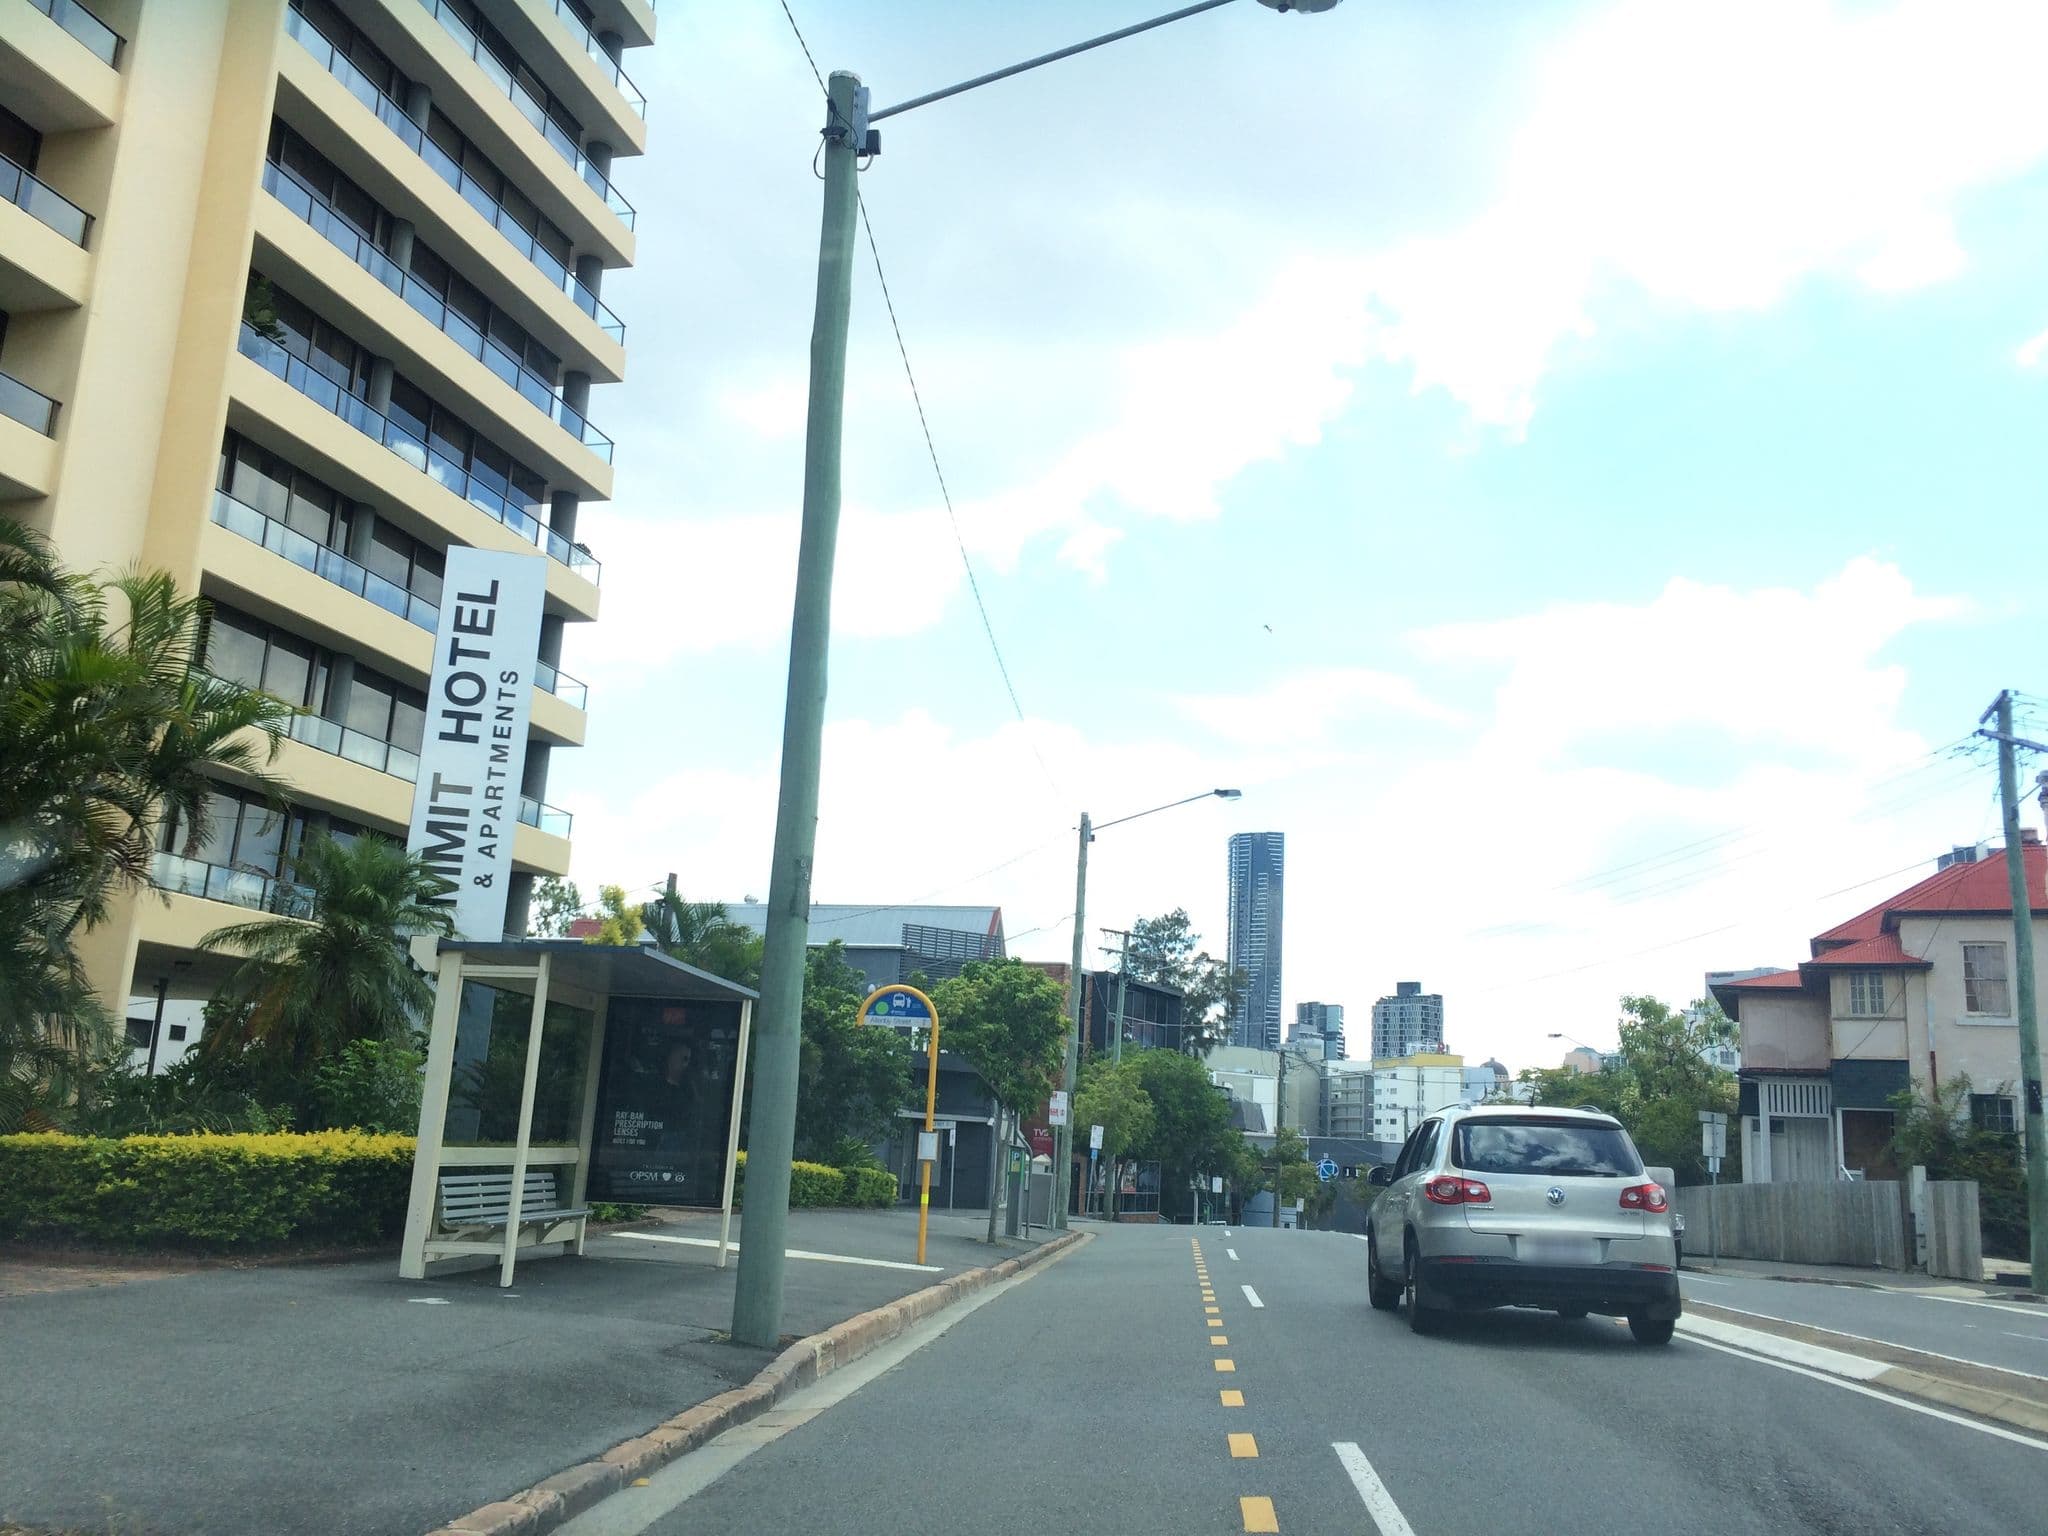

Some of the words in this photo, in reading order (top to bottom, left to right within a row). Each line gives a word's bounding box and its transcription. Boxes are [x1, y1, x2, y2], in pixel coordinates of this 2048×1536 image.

[438, 579, 500, 744] HOTEL
[479, 669, 519, 860] APARTMENTS
[473, 873, 494, 889] &
[615, 1120, 663, 1129] PRESCRIPTION
[614, 1128, 638, 1136] LENSES
[630, 1171, 658, 1181] OPSM
